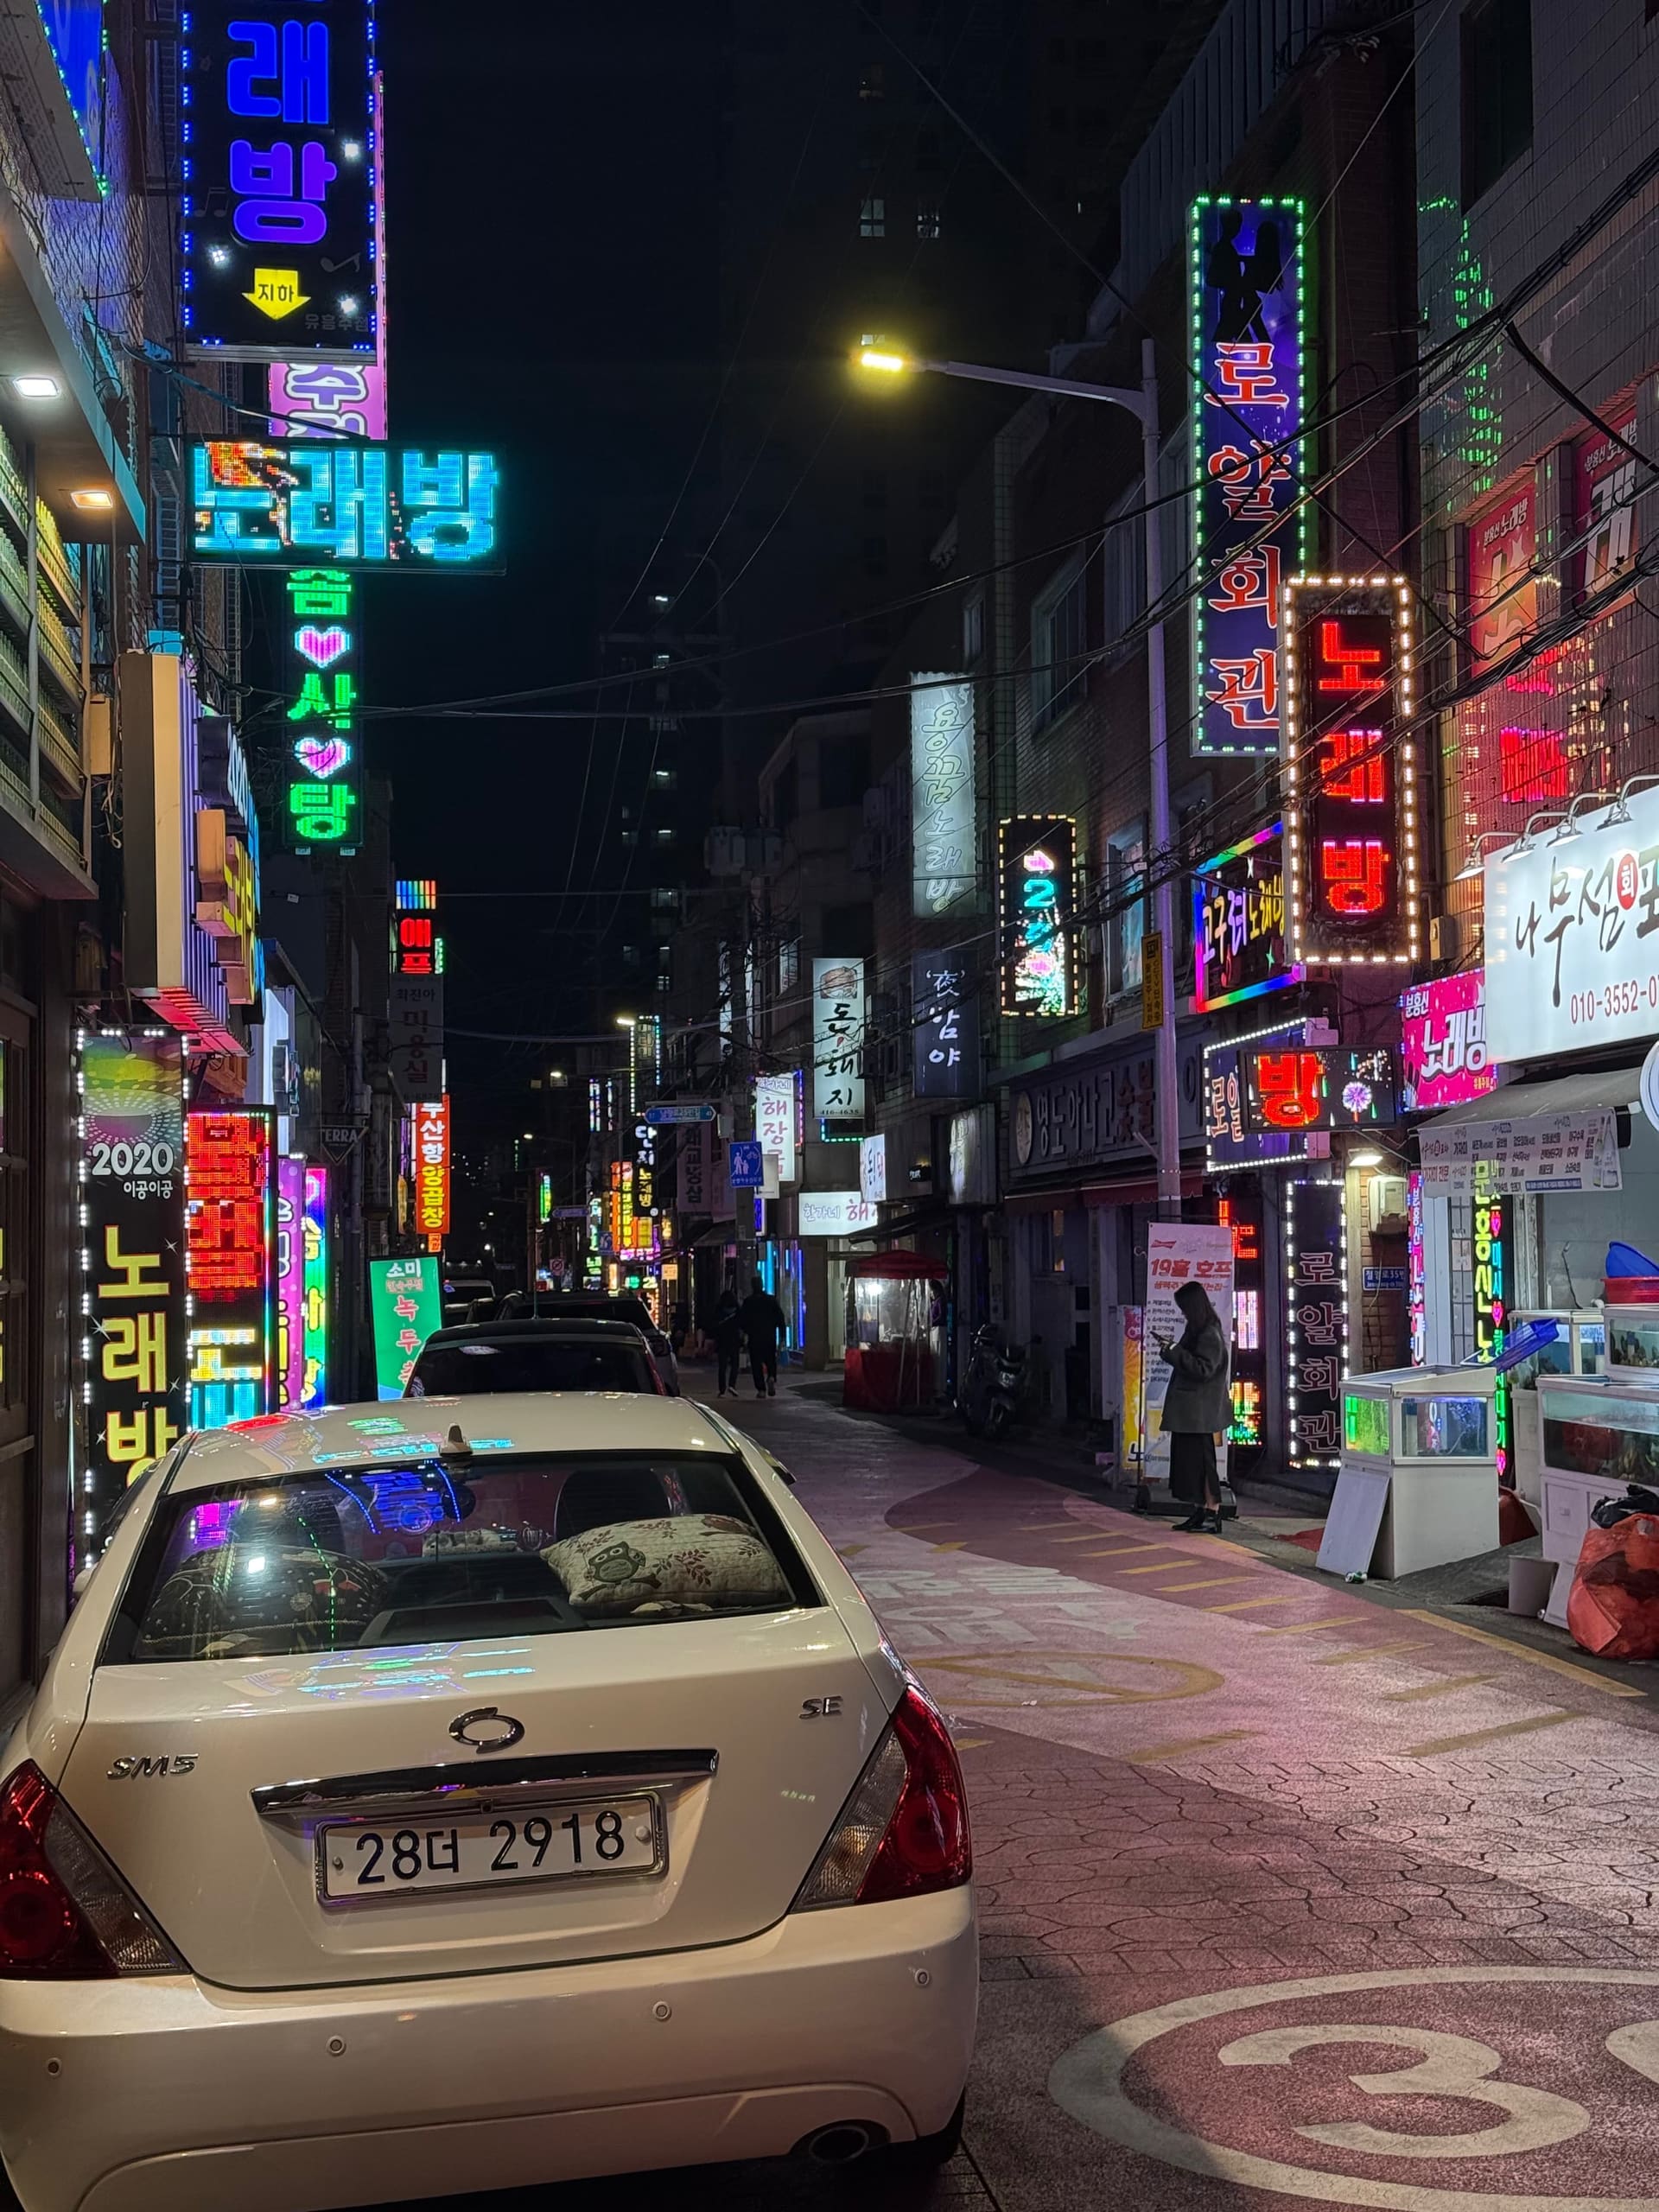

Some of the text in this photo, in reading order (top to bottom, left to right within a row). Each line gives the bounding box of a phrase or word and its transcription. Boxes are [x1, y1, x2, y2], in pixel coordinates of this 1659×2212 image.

[257, 283, 295, 303] 지하
[194, 448, 498, 561] 노래방
[1501, 498, 1528, 537] 노래방
[1205, 342, 1292, 729] 로얄회관
[1319, 621, 1389, 913] 노래방
[1406, 991, 1429, 1018] 분홍신
[1571, 975, 1659, 1024] 010-3552-0
[403, 1009, 429, 1084] 미용실
[1421, 1007, 1487, 1077] 노래방
[1258, 1054, 1324, 1127] 방
[92, 1142, 173, 1175] 2020
[124, 1180, 173, 1198] 이공이공
[804, 1204, 840, 1222] 한가네
[386, 1259, 421, 1278] 소미
[98, 1224, 178, 1489] 노래방
[1294, 1252, 1344, 1453] 로얄회관
[798, 1695, 843, 1719] SE
[105, 1752, 199, 1781] SM5
[356, 1809, 625, 1885] 28더 2918
